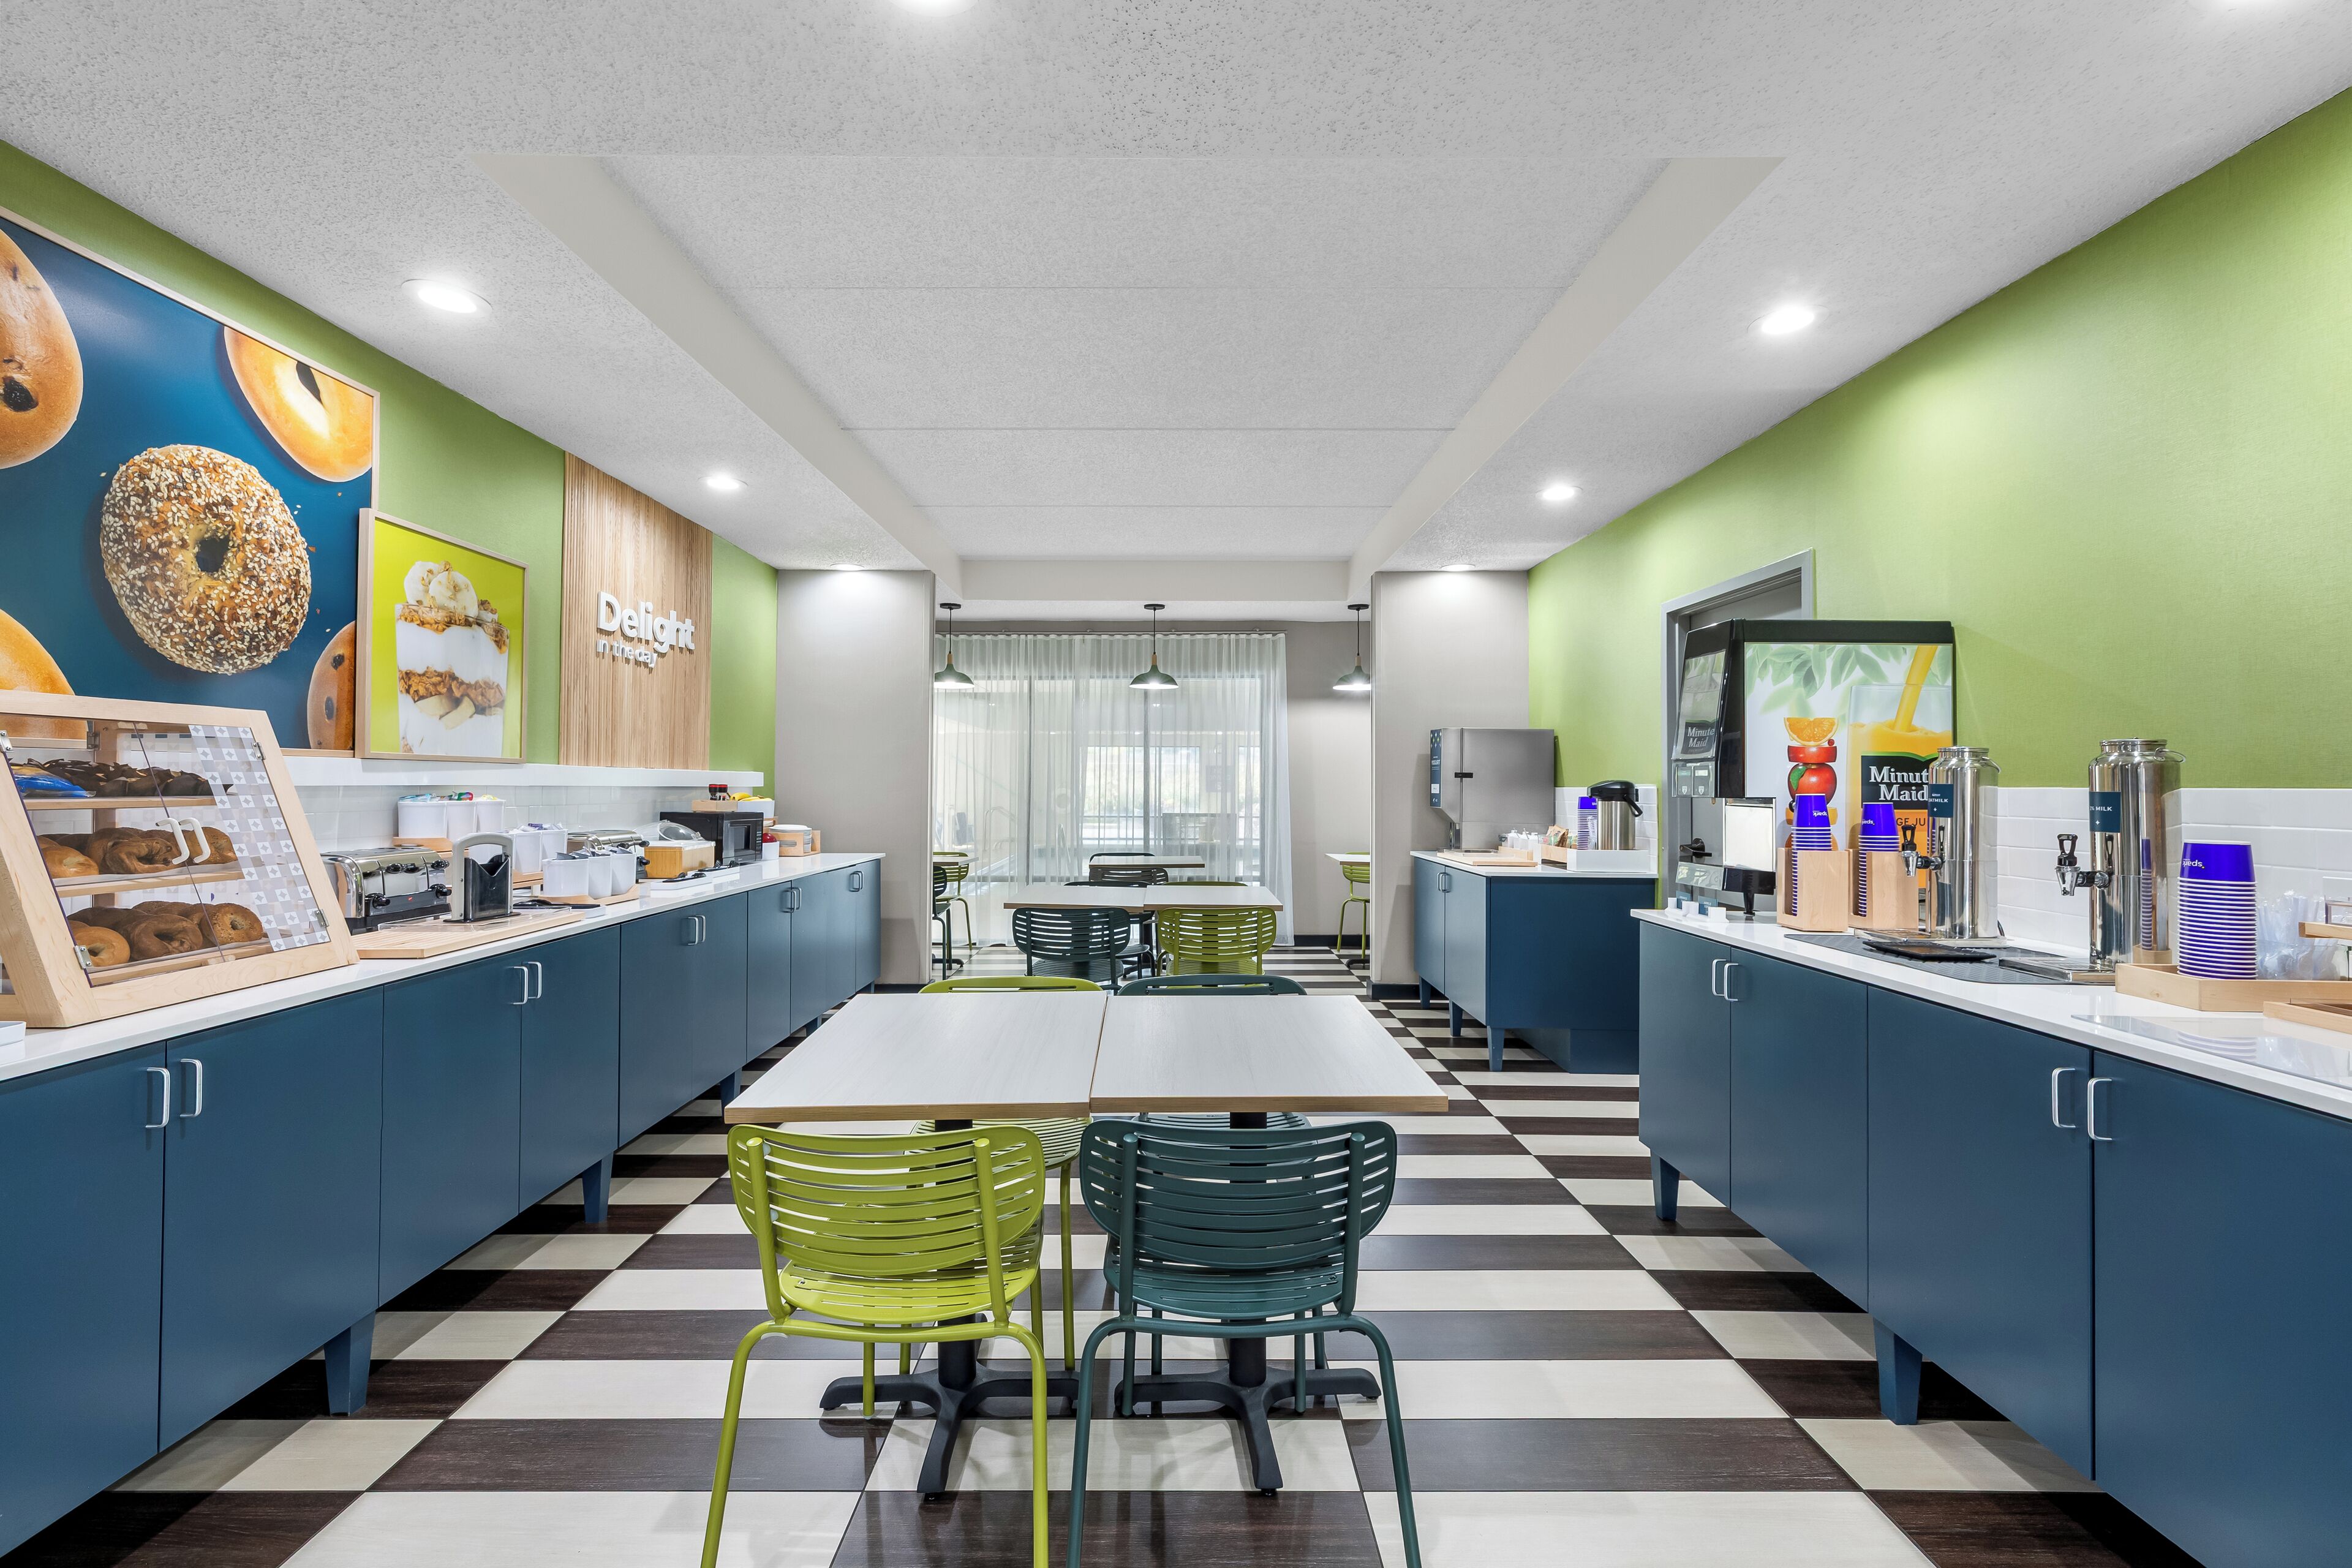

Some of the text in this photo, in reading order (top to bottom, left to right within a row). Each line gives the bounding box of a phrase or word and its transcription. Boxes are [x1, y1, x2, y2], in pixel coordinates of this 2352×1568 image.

[597, 591, 695, 653] Delight
[612, 640, 634, 659] the
[635, 646, 658, 668] day
[1687, 727, 1714, 736] Minute
[1689, 737, 1708, 747] Maid
[1869, 766, 1929, 783] Minut
[1879, 784, 1929, 801] Maid
